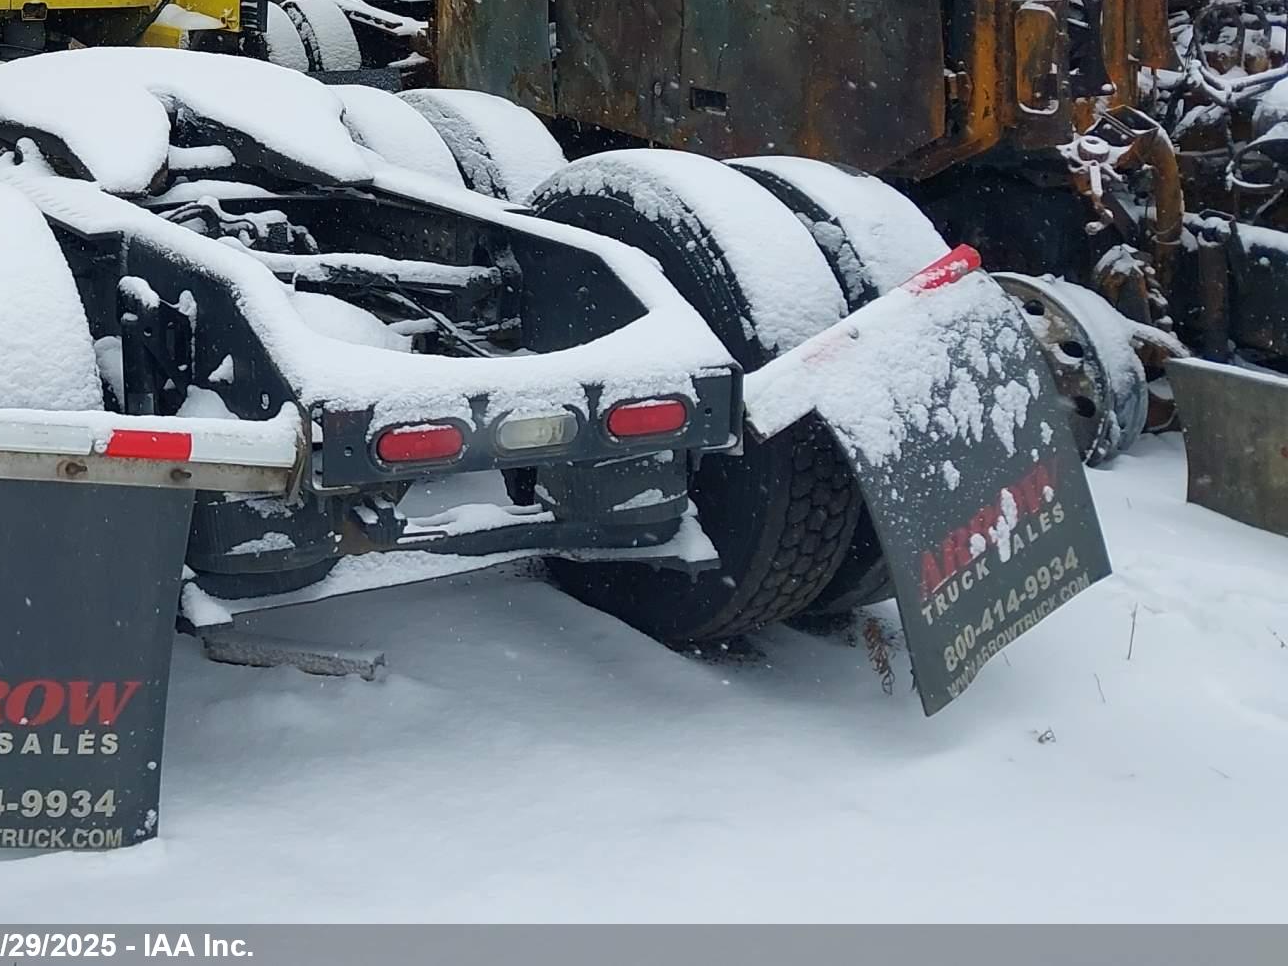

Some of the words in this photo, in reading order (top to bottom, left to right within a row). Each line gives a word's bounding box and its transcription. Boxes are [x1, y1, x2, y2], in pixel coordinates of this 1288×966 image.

[920, 557, 991, 626] TRUCK
[1012, 501, 1066, 556] ALES
[943, 545, 1080, 673] 800-414-9934
